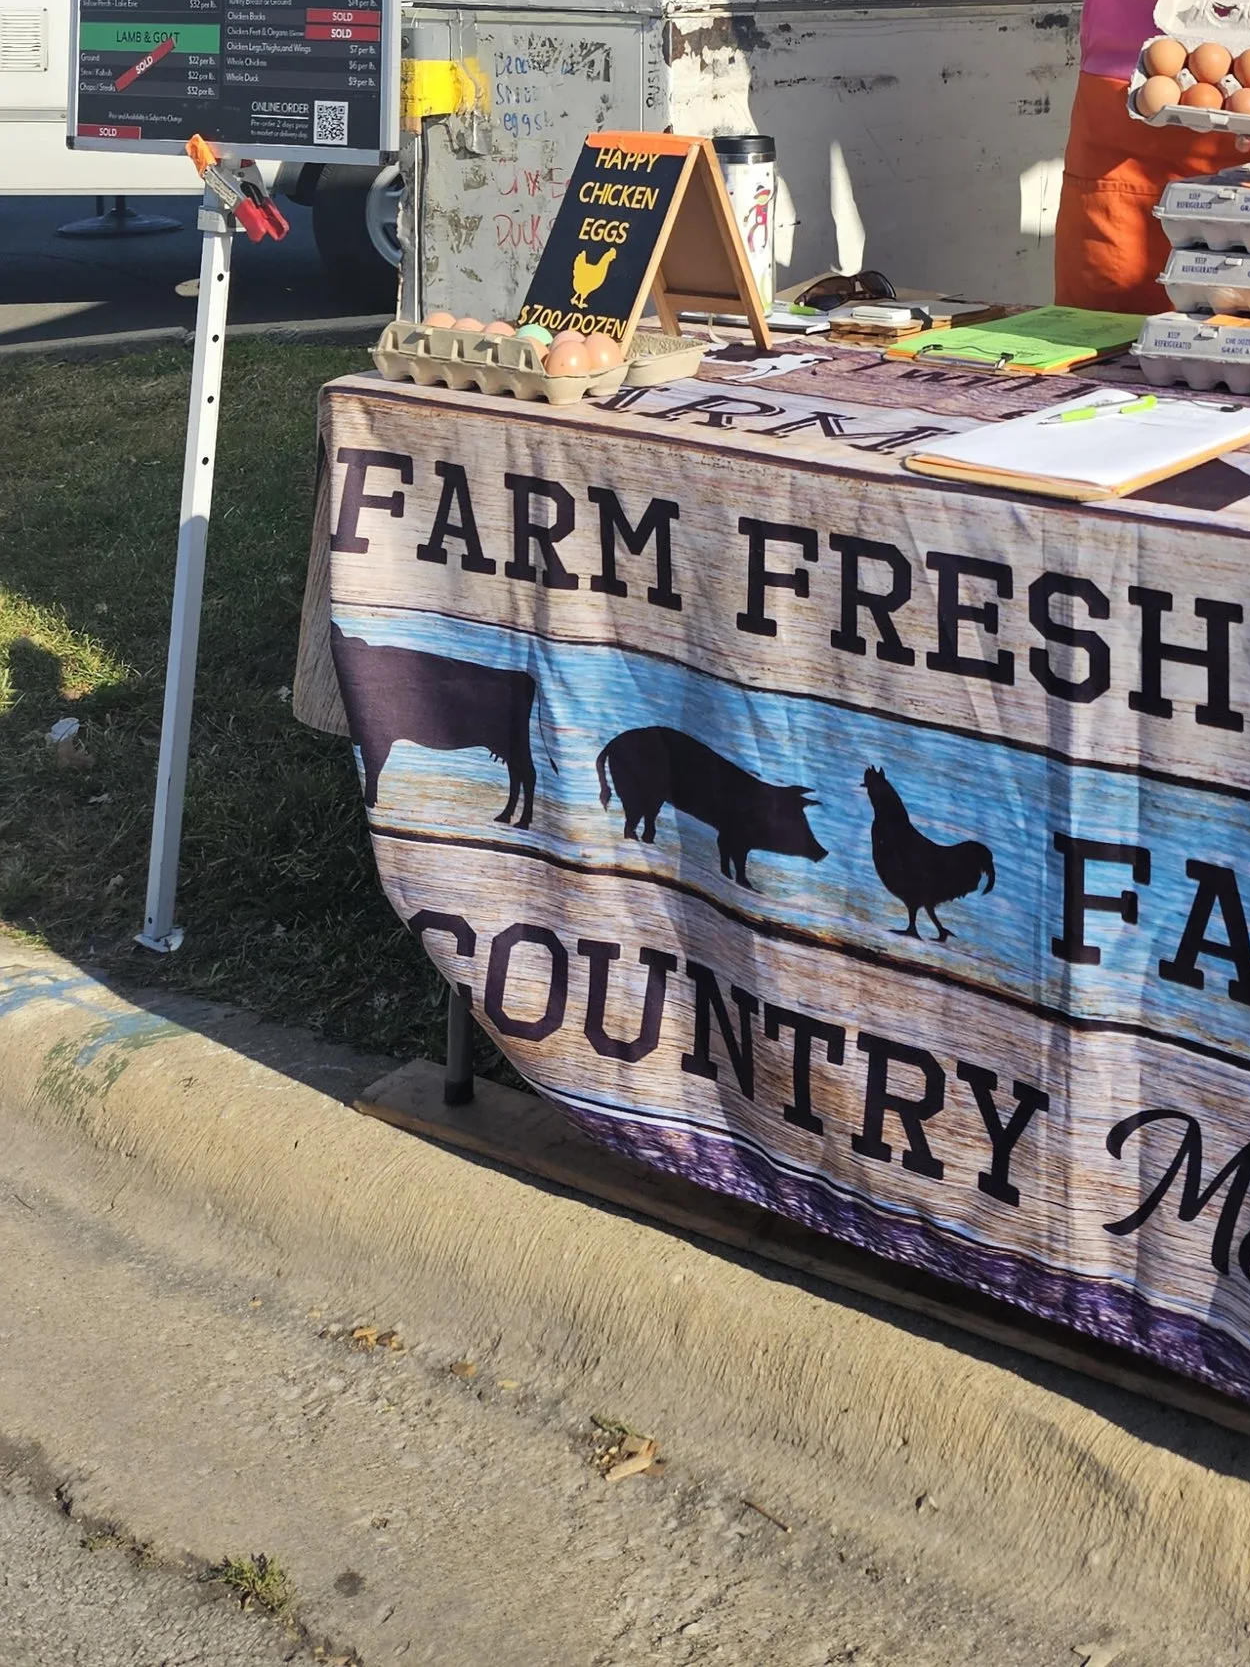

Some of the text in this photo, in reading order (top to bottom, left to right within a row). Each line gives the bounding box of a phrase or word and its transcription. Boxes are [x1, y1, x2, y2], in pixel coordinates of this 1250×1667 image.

[332, 12, 352, 21] SOLD
[116, 32, 141, 42] LAMB
[144, 32, 151, 43] &
[331, 29, 352, 38] SOLD
[136, 56, 153, 74] SOLD
[252, 102, 309, 113] ONLINE ORDER
[99, 128, 117, 137] SOLD
[595, 147, 661, 173] HAPPY
[578, 180, 660, 211] CHICKEN
[578, 217, 631, 245] EGGS
[331, 446, 682, 612] FARM
[737, 516, 1243, 732] FRESH
[408, 908, 1049, 1206] COUNTRY
